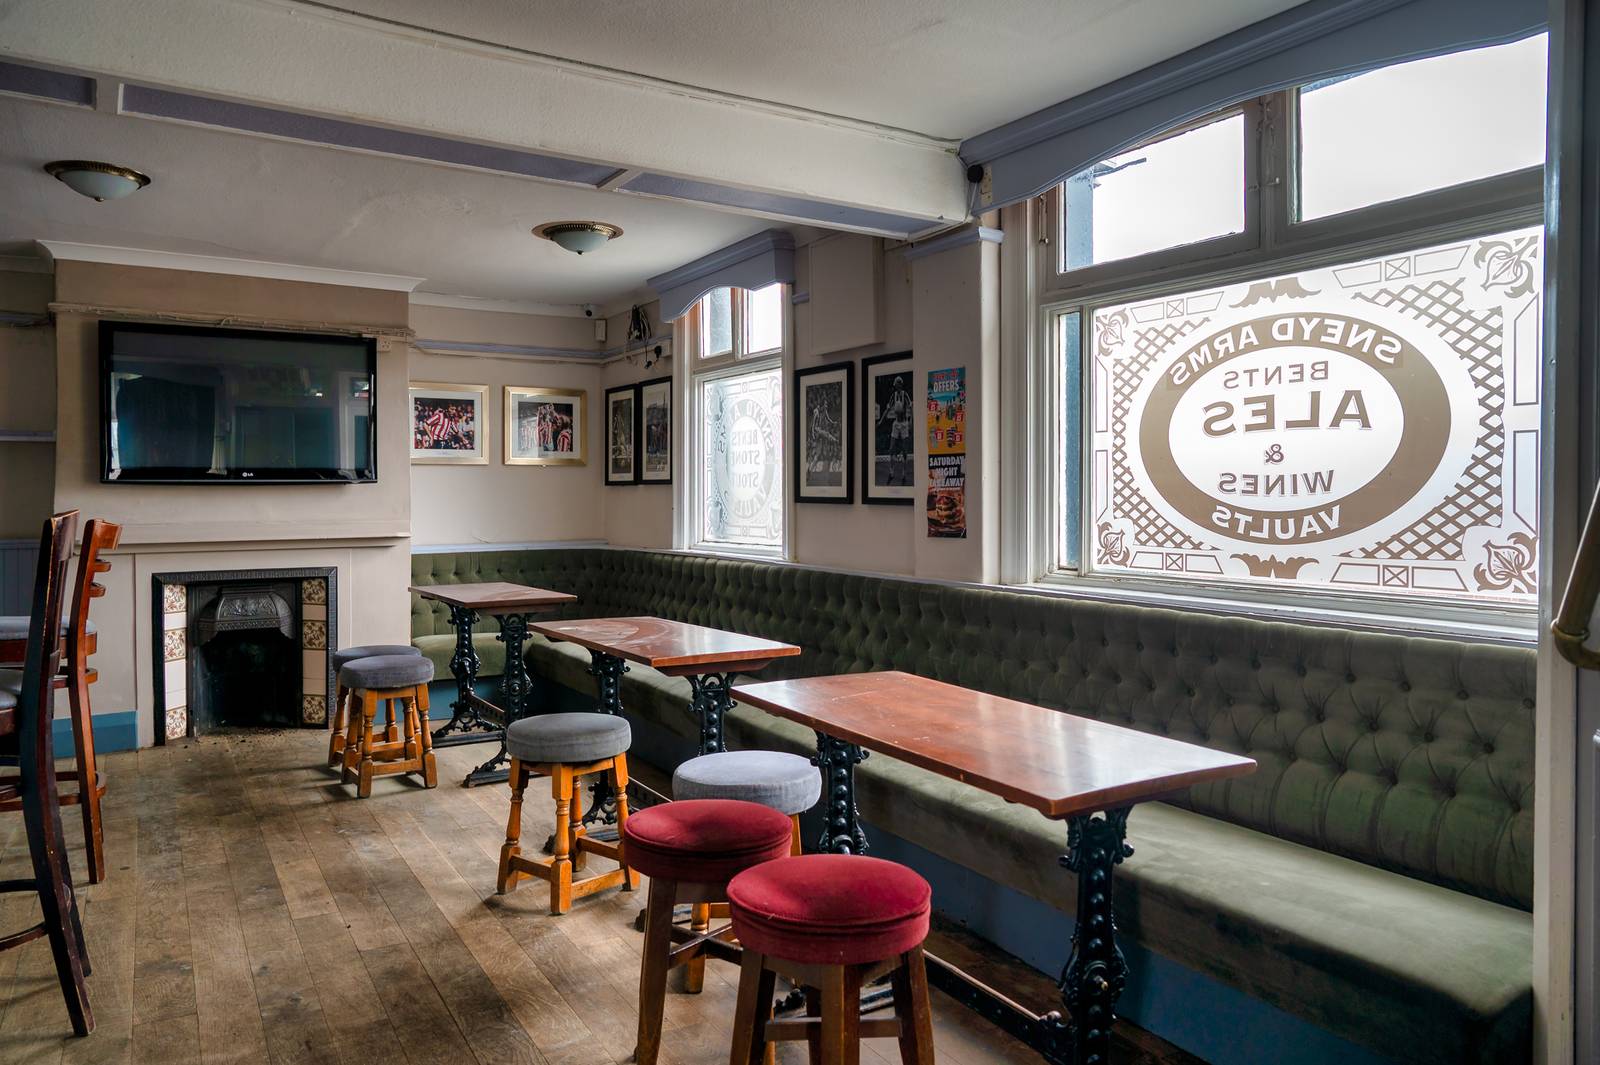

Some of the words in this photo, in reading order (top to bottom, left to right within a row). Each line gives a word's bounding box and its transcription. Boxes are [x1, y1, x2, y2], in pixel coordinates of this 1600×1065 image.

[933, 380, 960, 392] OFFERS
[929, 455, 965, 466] SATURDAY
[934, 466, 958, 476] NIGHT
[929, 478, 965, 487] TAKEAWAY
